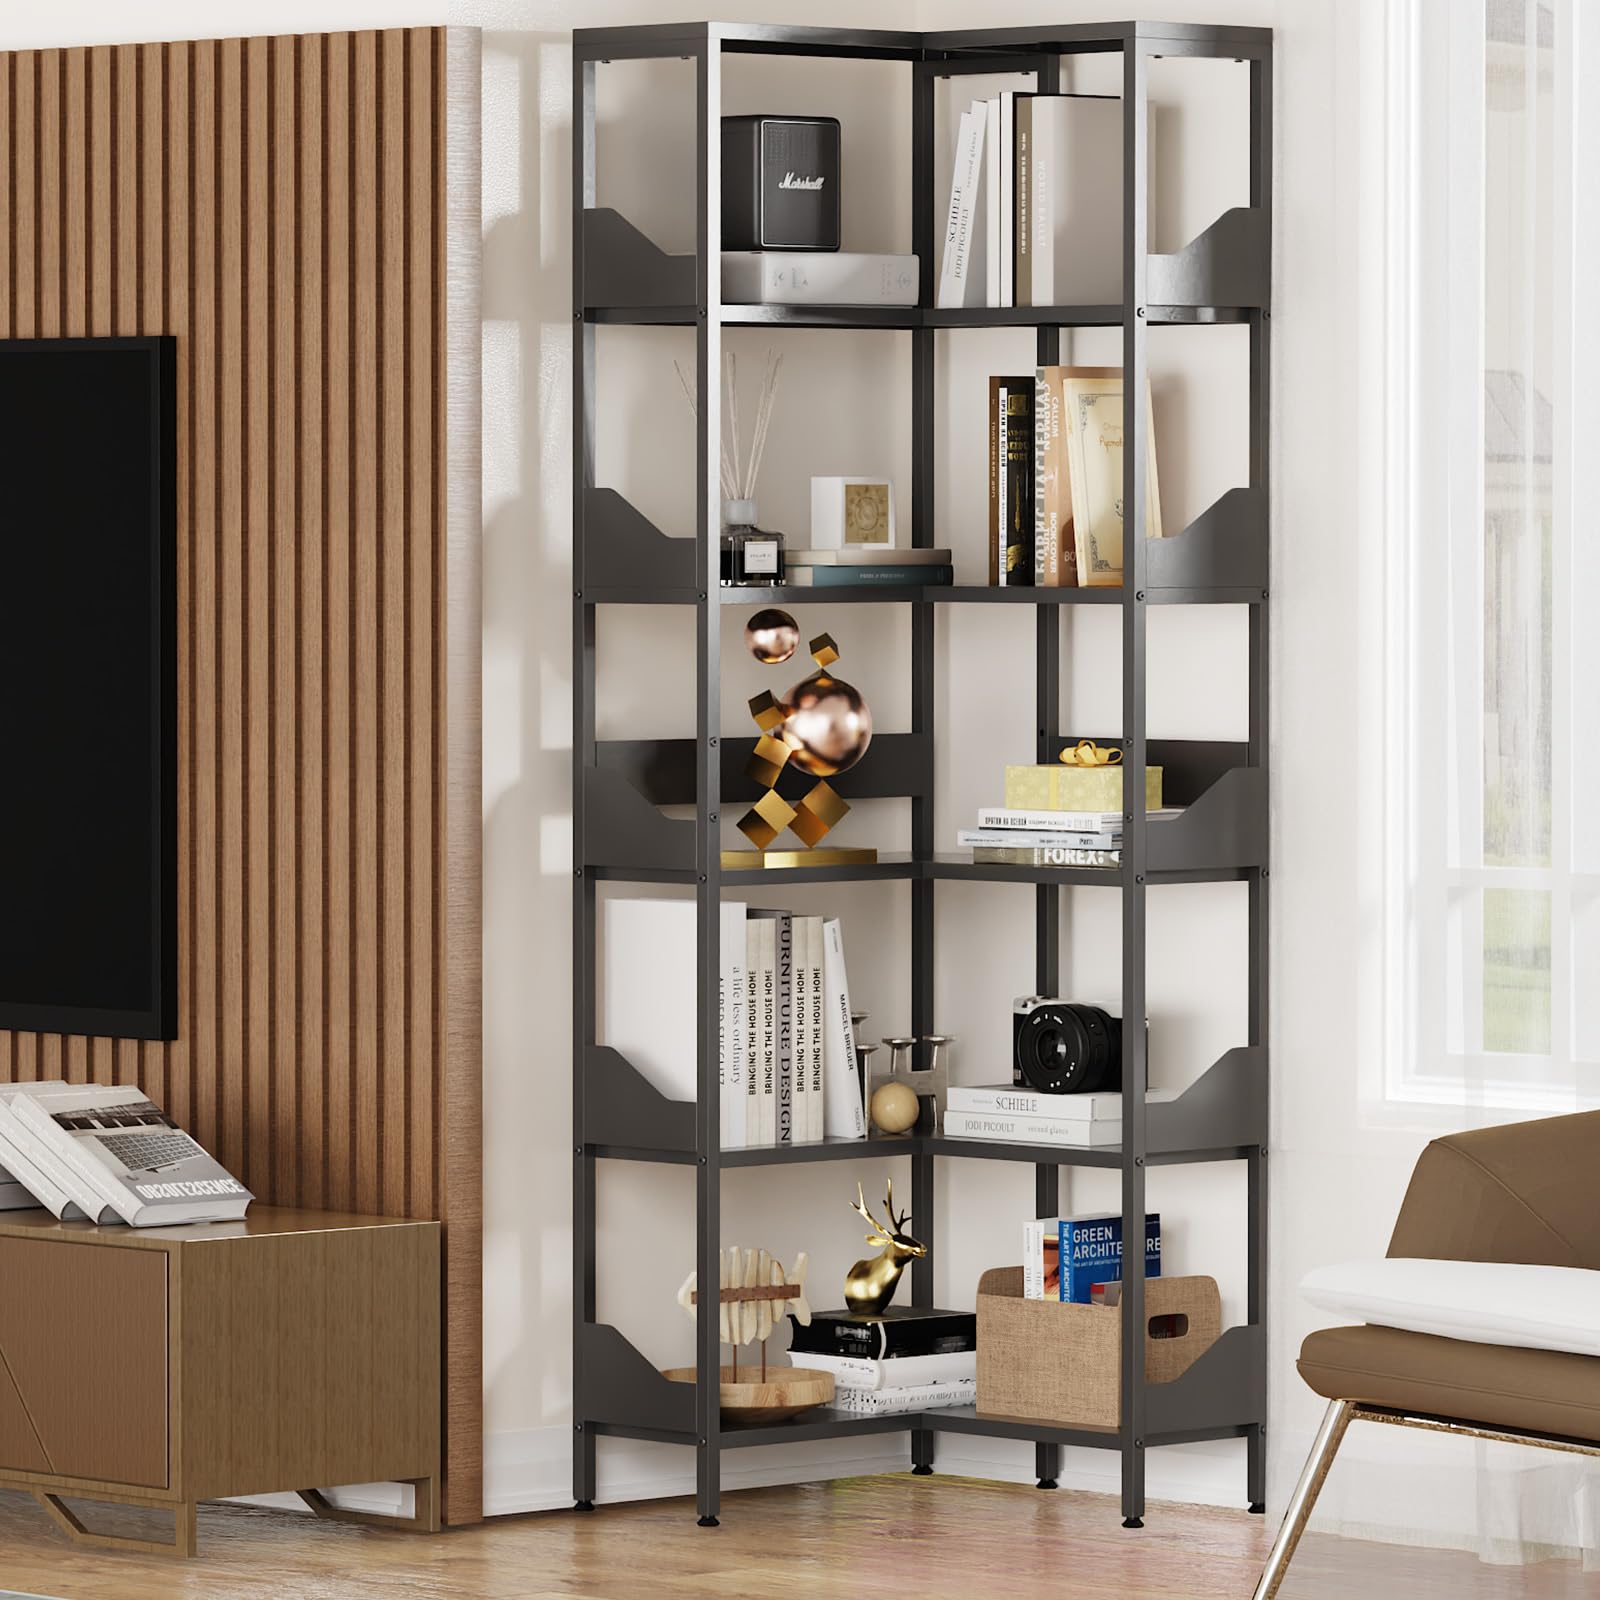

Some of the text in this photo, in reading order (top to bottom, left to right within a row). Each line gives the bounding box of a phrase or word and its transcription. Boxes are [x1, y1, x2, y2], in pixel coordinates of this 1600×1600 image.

[778, 172, 825, 190] Marshall
[1037, 160, 1047, 200] WORLD
[947, 185, 963, 243] SCHIELE
[957, 207, 969, 253] PICOULT
[953, 254, 964, 279] JODI
[1051, 396, 1059, 437] CALLUM
[1049, 539, 1057, 573] COVER
[732, 977, 743, 999] life
[732, 1002, 743, 1025] less
[748, 970, 757, 1096] BRINGING THE HOUSE HOME
[764, 969, 773, 1094] BRINGING THE HOUSE HOME
[781, 915, 791, 1141] FURNITURE DESIGN
[796, 968, 805, 1092] BRINGING THE HOUSE HOME
[812, 967, 821, 1091] BRINGING THE HOUSE HOME
[839, 993, 855, 1071] MARCEL BREUER
[730, 1029, 743, 1085] ordinary
[995, 1096, 1038, 1112] SCHIELE
[965, 1119, 982, 1131] JODI
[983, 1120, 1015, 1133] PICOULT
[1073, 1226, 1113, 1243] GREEN
[1063, 1255, 1070, 1265] OF
